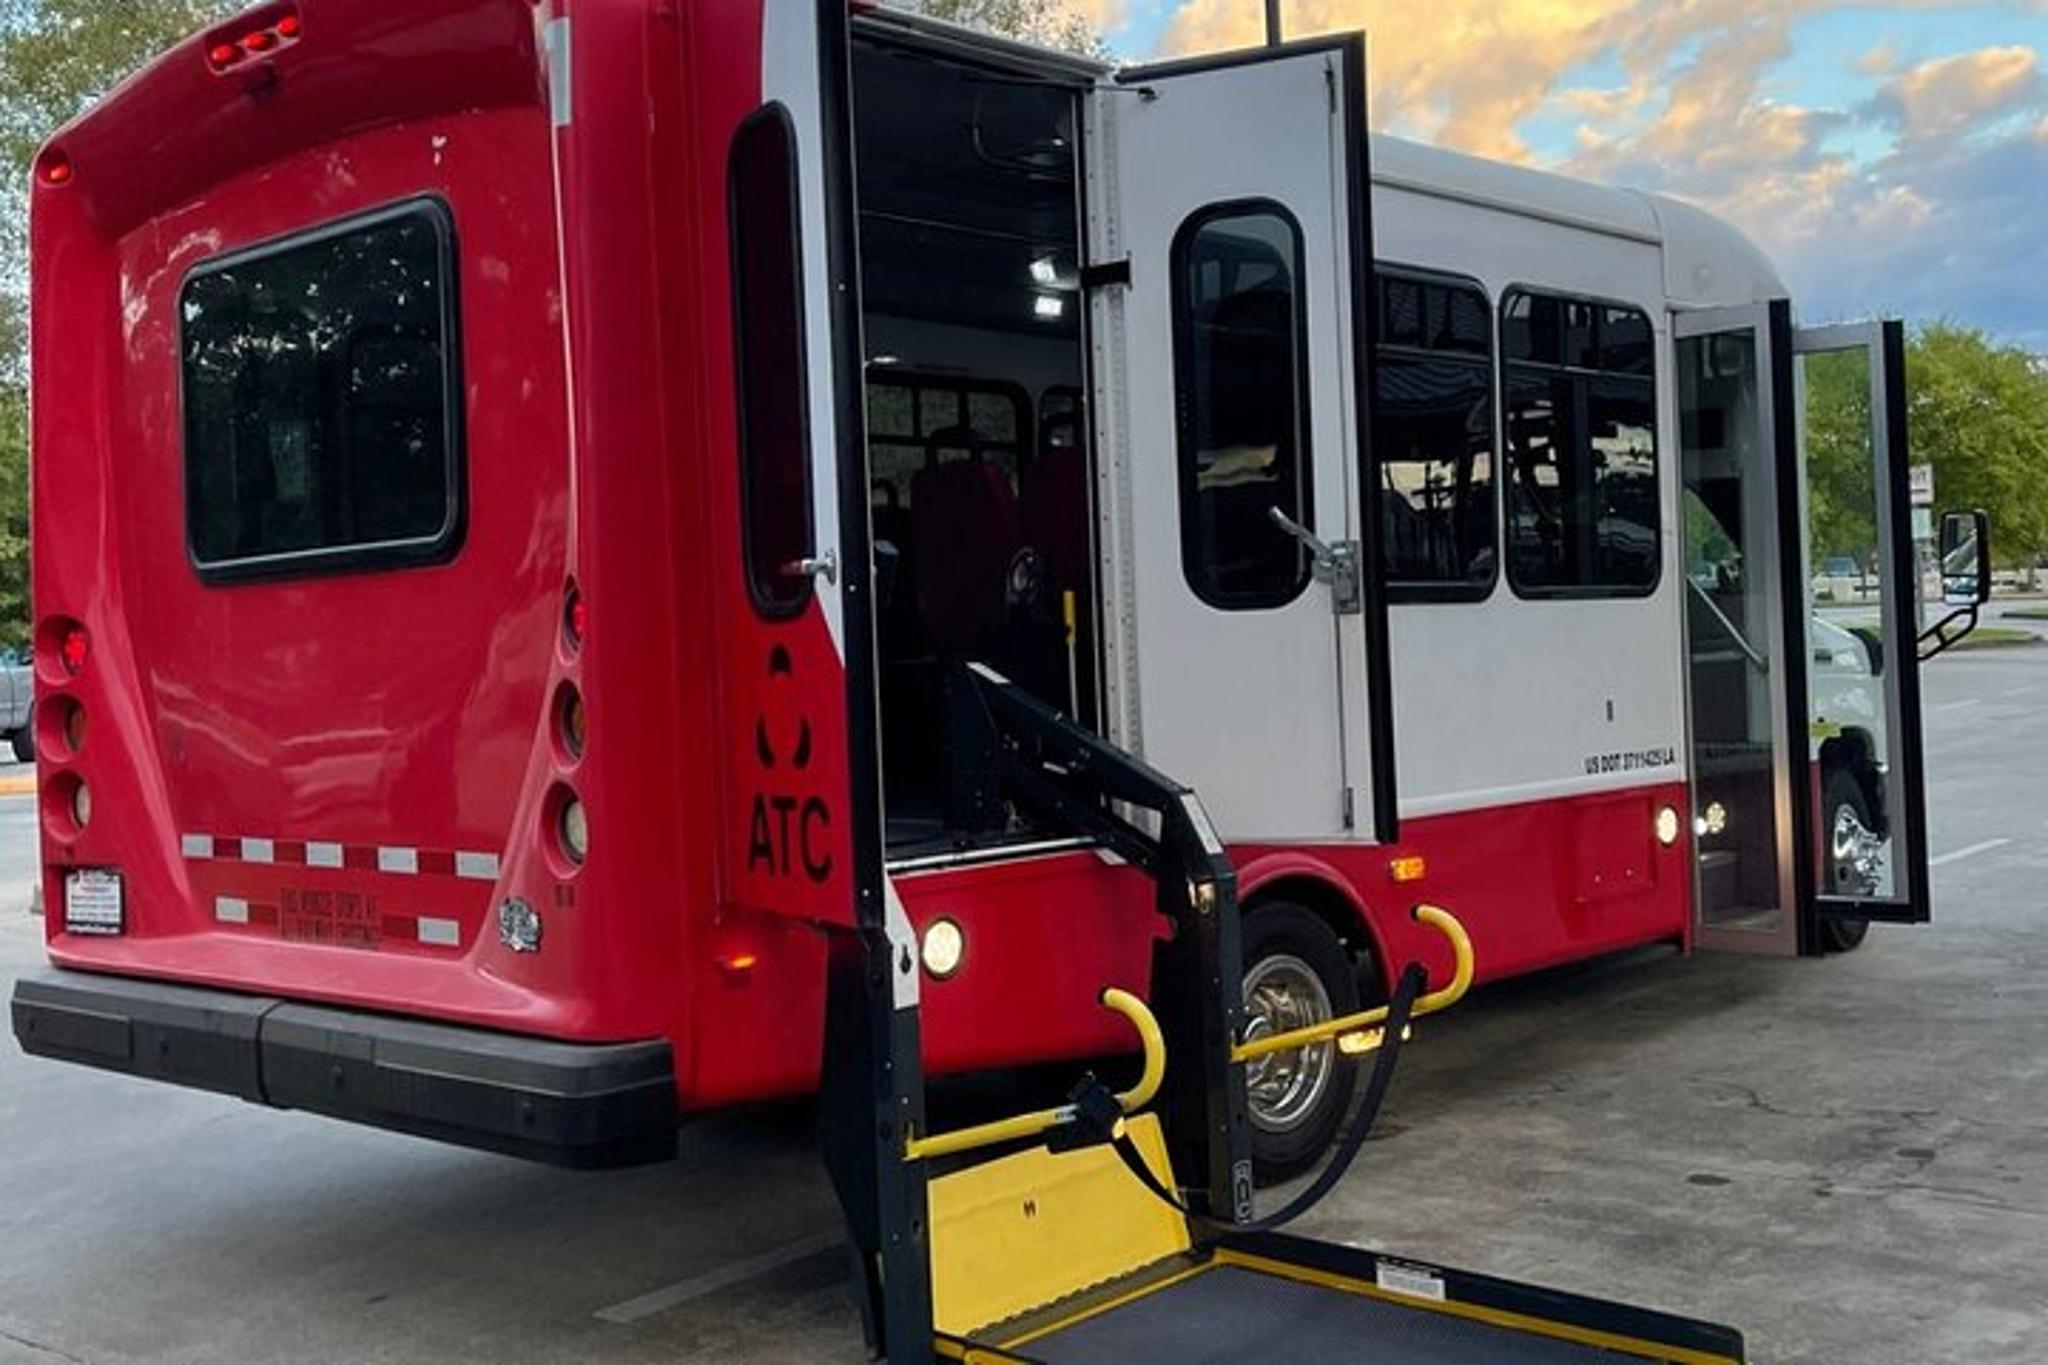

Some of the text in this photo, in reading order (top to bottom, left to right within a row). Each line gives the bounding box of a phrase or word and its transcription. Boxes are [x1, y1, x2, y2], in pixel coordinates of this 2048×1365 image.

[1585, 756, 1599, 775] US
[1601, 752, 1621, 773] DOT
[1663, 746, 1675, 765] LA
[748, 794, 832, 884] ATC
